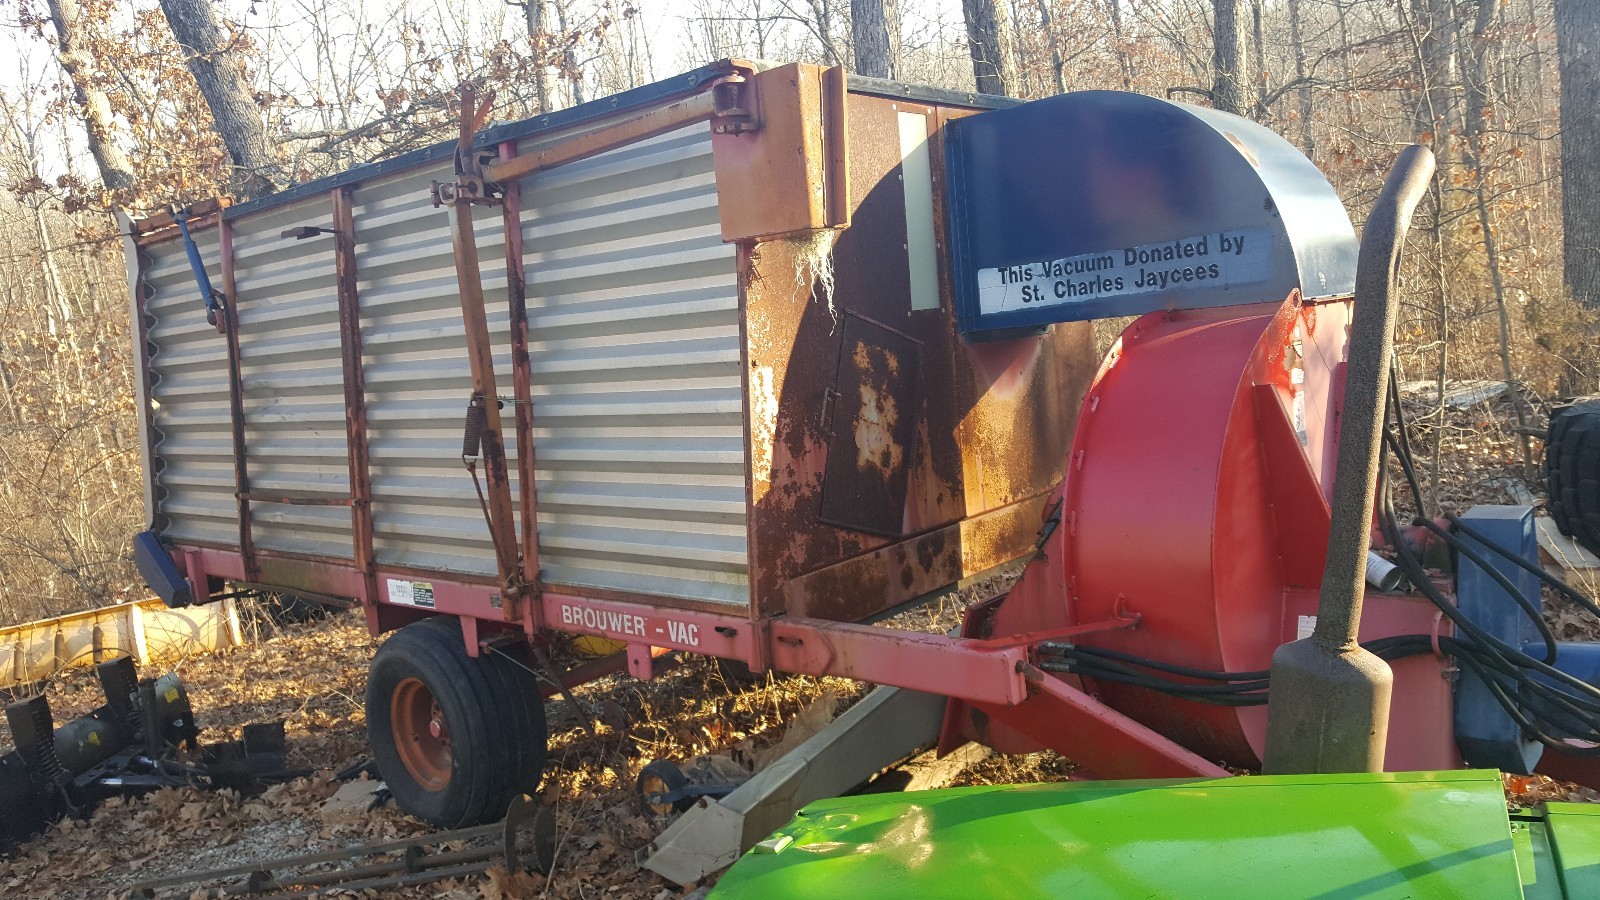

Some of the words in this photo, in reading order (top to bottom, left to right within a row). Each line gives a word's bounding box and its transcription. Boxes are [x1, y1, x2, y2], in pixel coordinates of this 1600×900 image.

[998, 265, 1033, 284] This
[1042, 255, 1114, 279] Vacuum
[1124, 236, 1208, 266] Donated
[1220, 233, 1245, 255] by
[1021, 285, 1045, 303] St.
[1054, 275, 1124, 299] Charles
[1135, 263, 1220, 289] Jaycees
[561, 604, 646, 637] BROUWER
[667, 620, 699, 646] VAC
